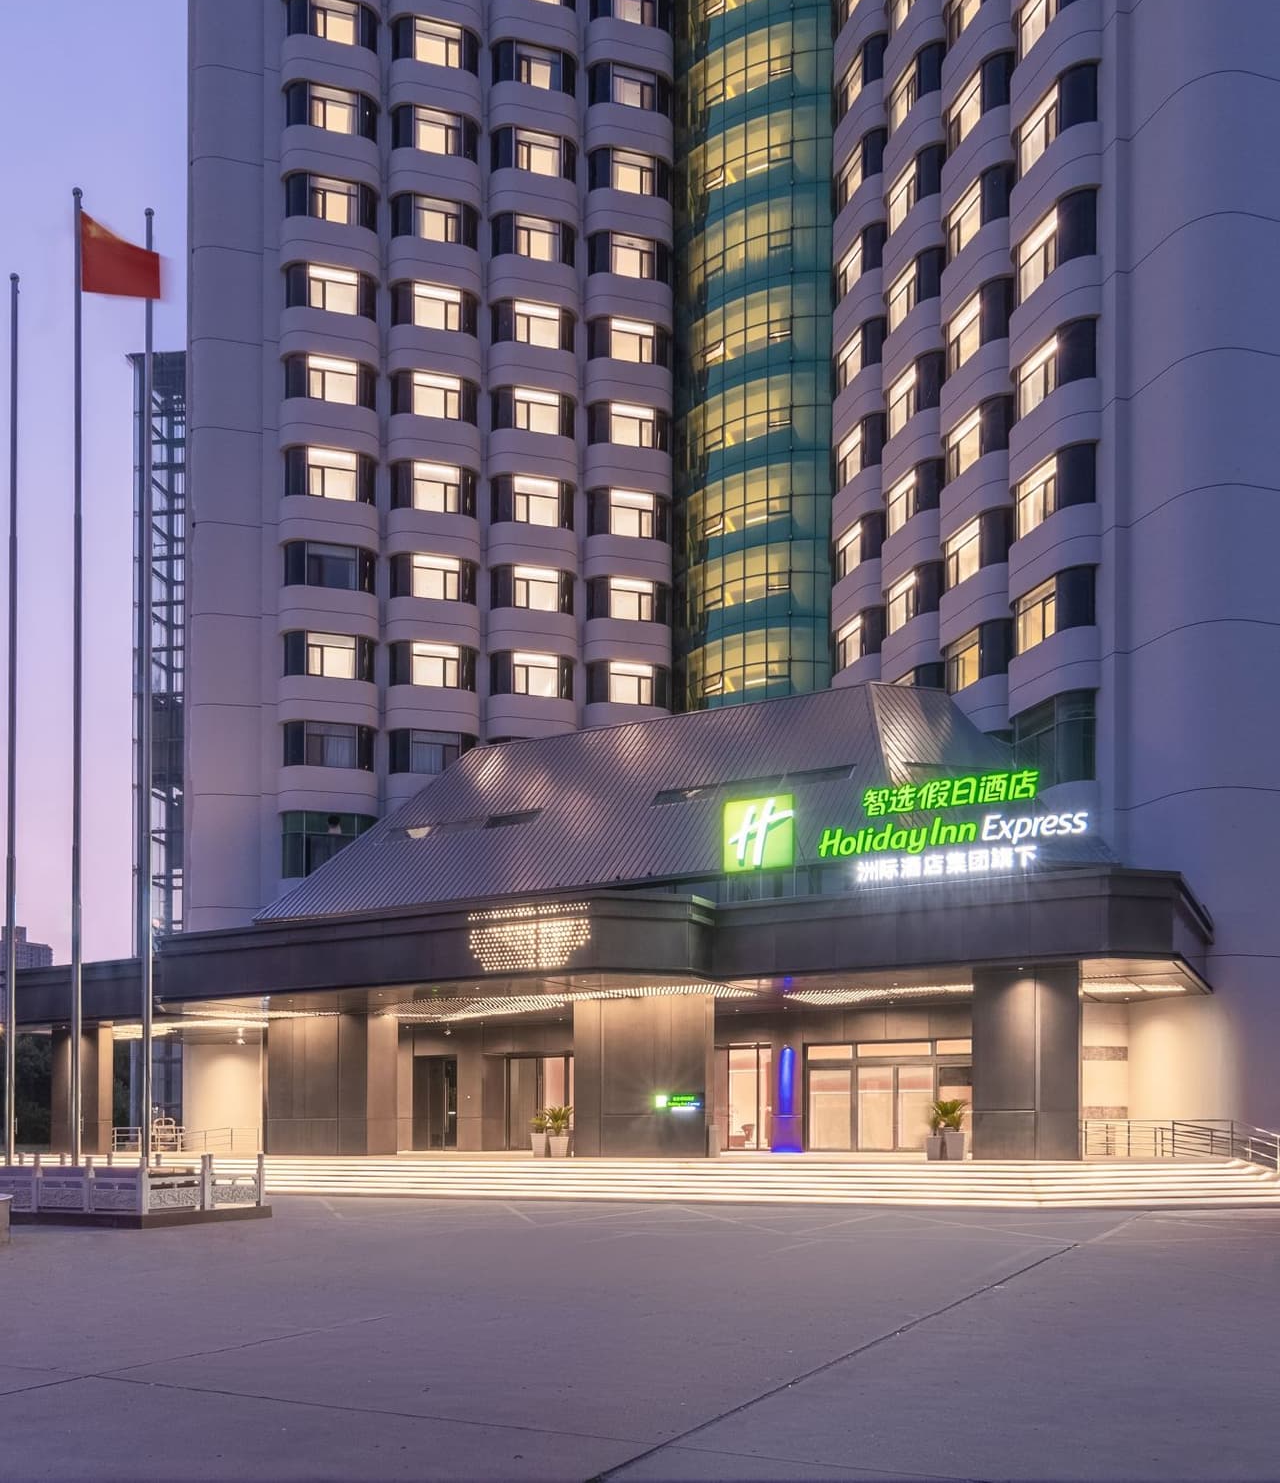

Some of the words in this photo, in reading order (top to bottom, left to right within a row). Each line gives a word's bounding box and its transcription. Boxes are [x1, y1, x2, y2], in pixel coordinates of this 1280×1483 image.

[863, 770, 1039, 816] 智选假日酒店
[980, 812, 1089, 845] Express
